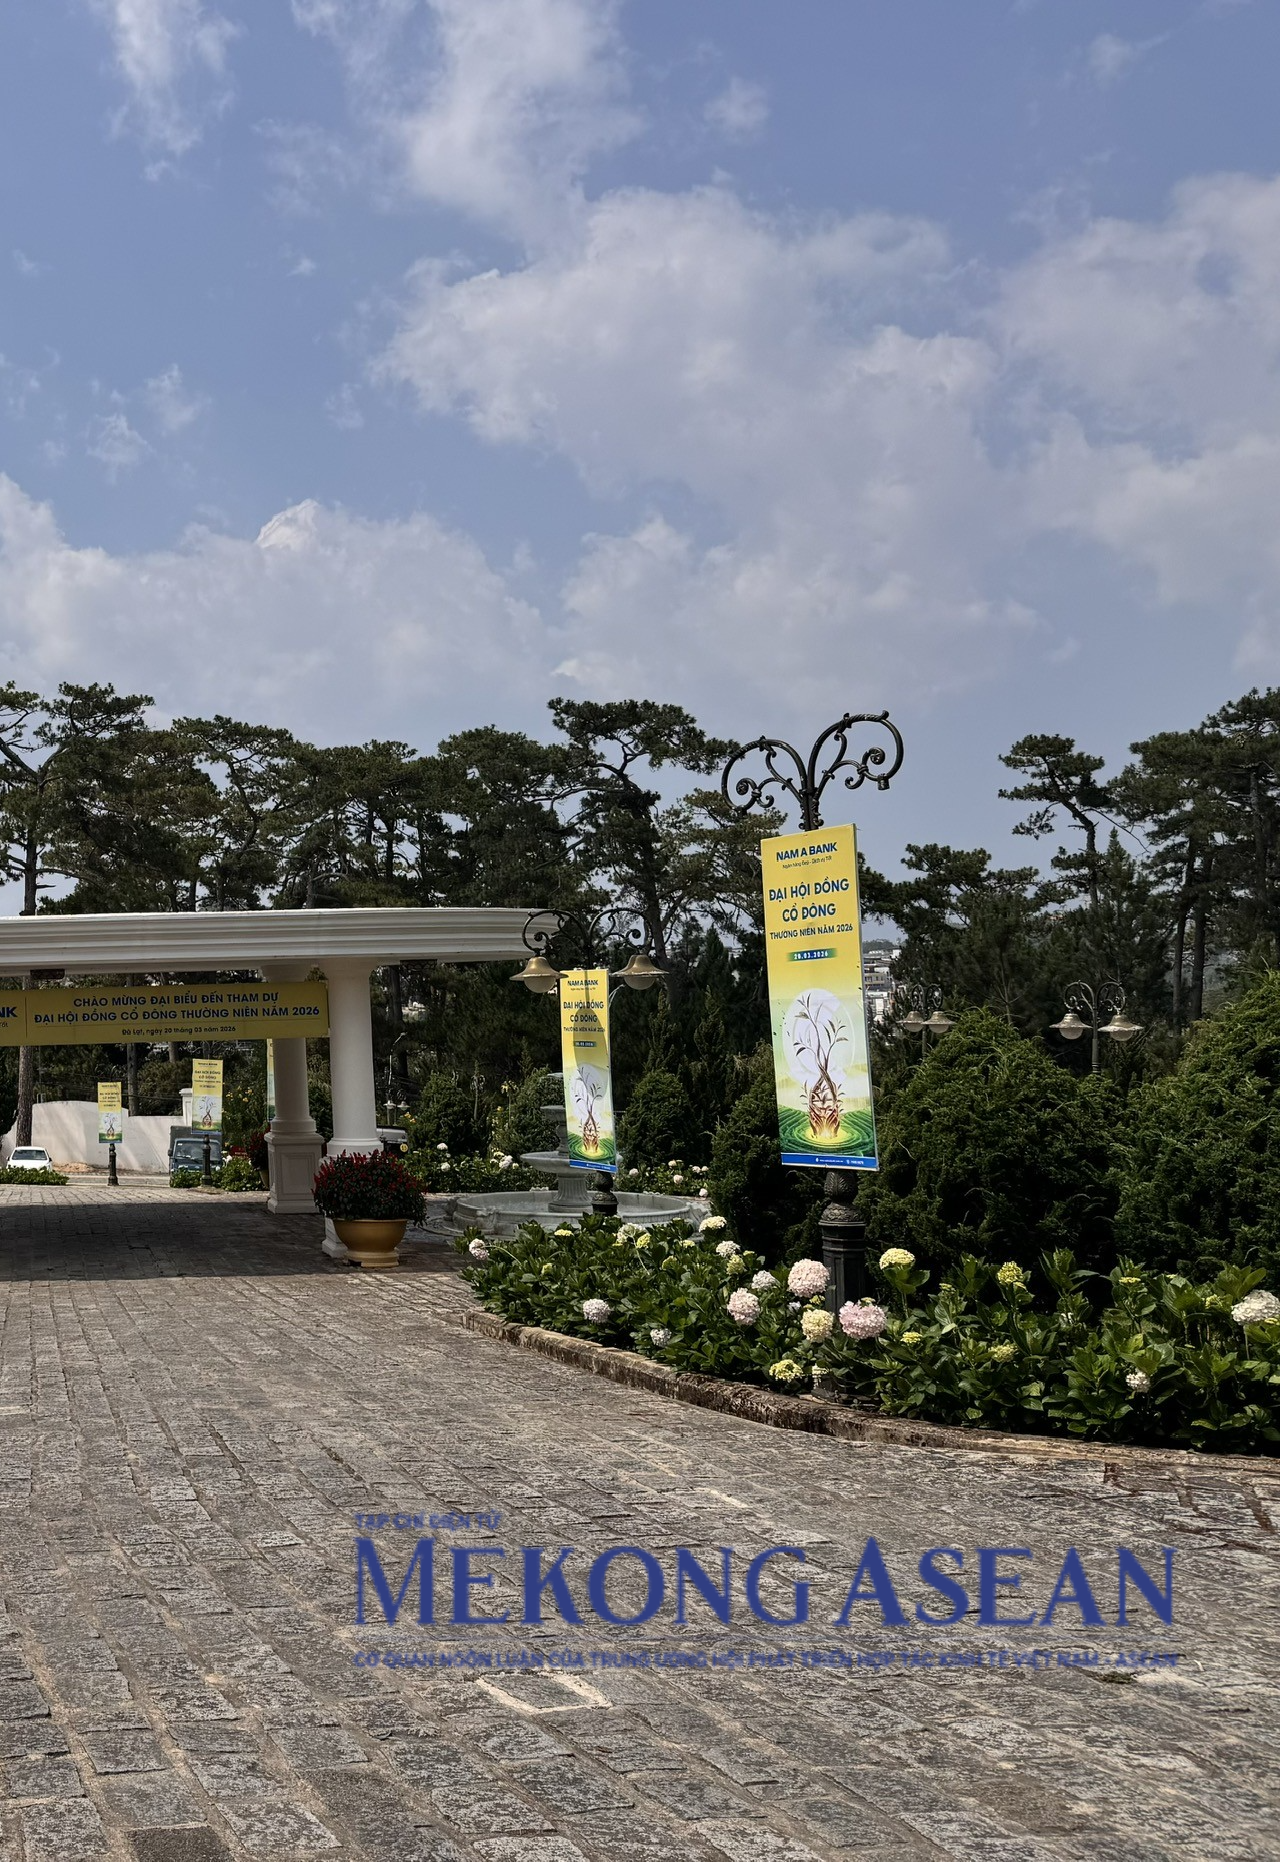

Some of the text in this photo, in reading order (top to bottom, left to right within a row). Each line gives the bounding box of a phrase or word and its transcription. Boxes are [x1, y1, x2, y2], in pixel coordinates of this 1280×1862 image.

[776, 842, 838, 862] NAM A BANK
[769, 876, 849, 903] ĐẠI HỘI ĐỒNG
[782, 903, 836, 922] CỔ ĐÔNG
[770, 923, 853, 939] THƯỜNG NIÊN NĂM 2026
[794, 950, 828, 960] 20.03.2026
[73, 990, 279, 1007] CHÀO MỪNG ĐẠI BIỂU ĐẾN THAM DỰ
[34, 1005, 320, 1025] ĐẠI HỘI ĐỒNG CỔ ĐÔNG THƯỜNG NIÊN NĂM 2026
[146, 1028, 162, 1036] ngày
[174, 1027, 192, 1035] tháng
